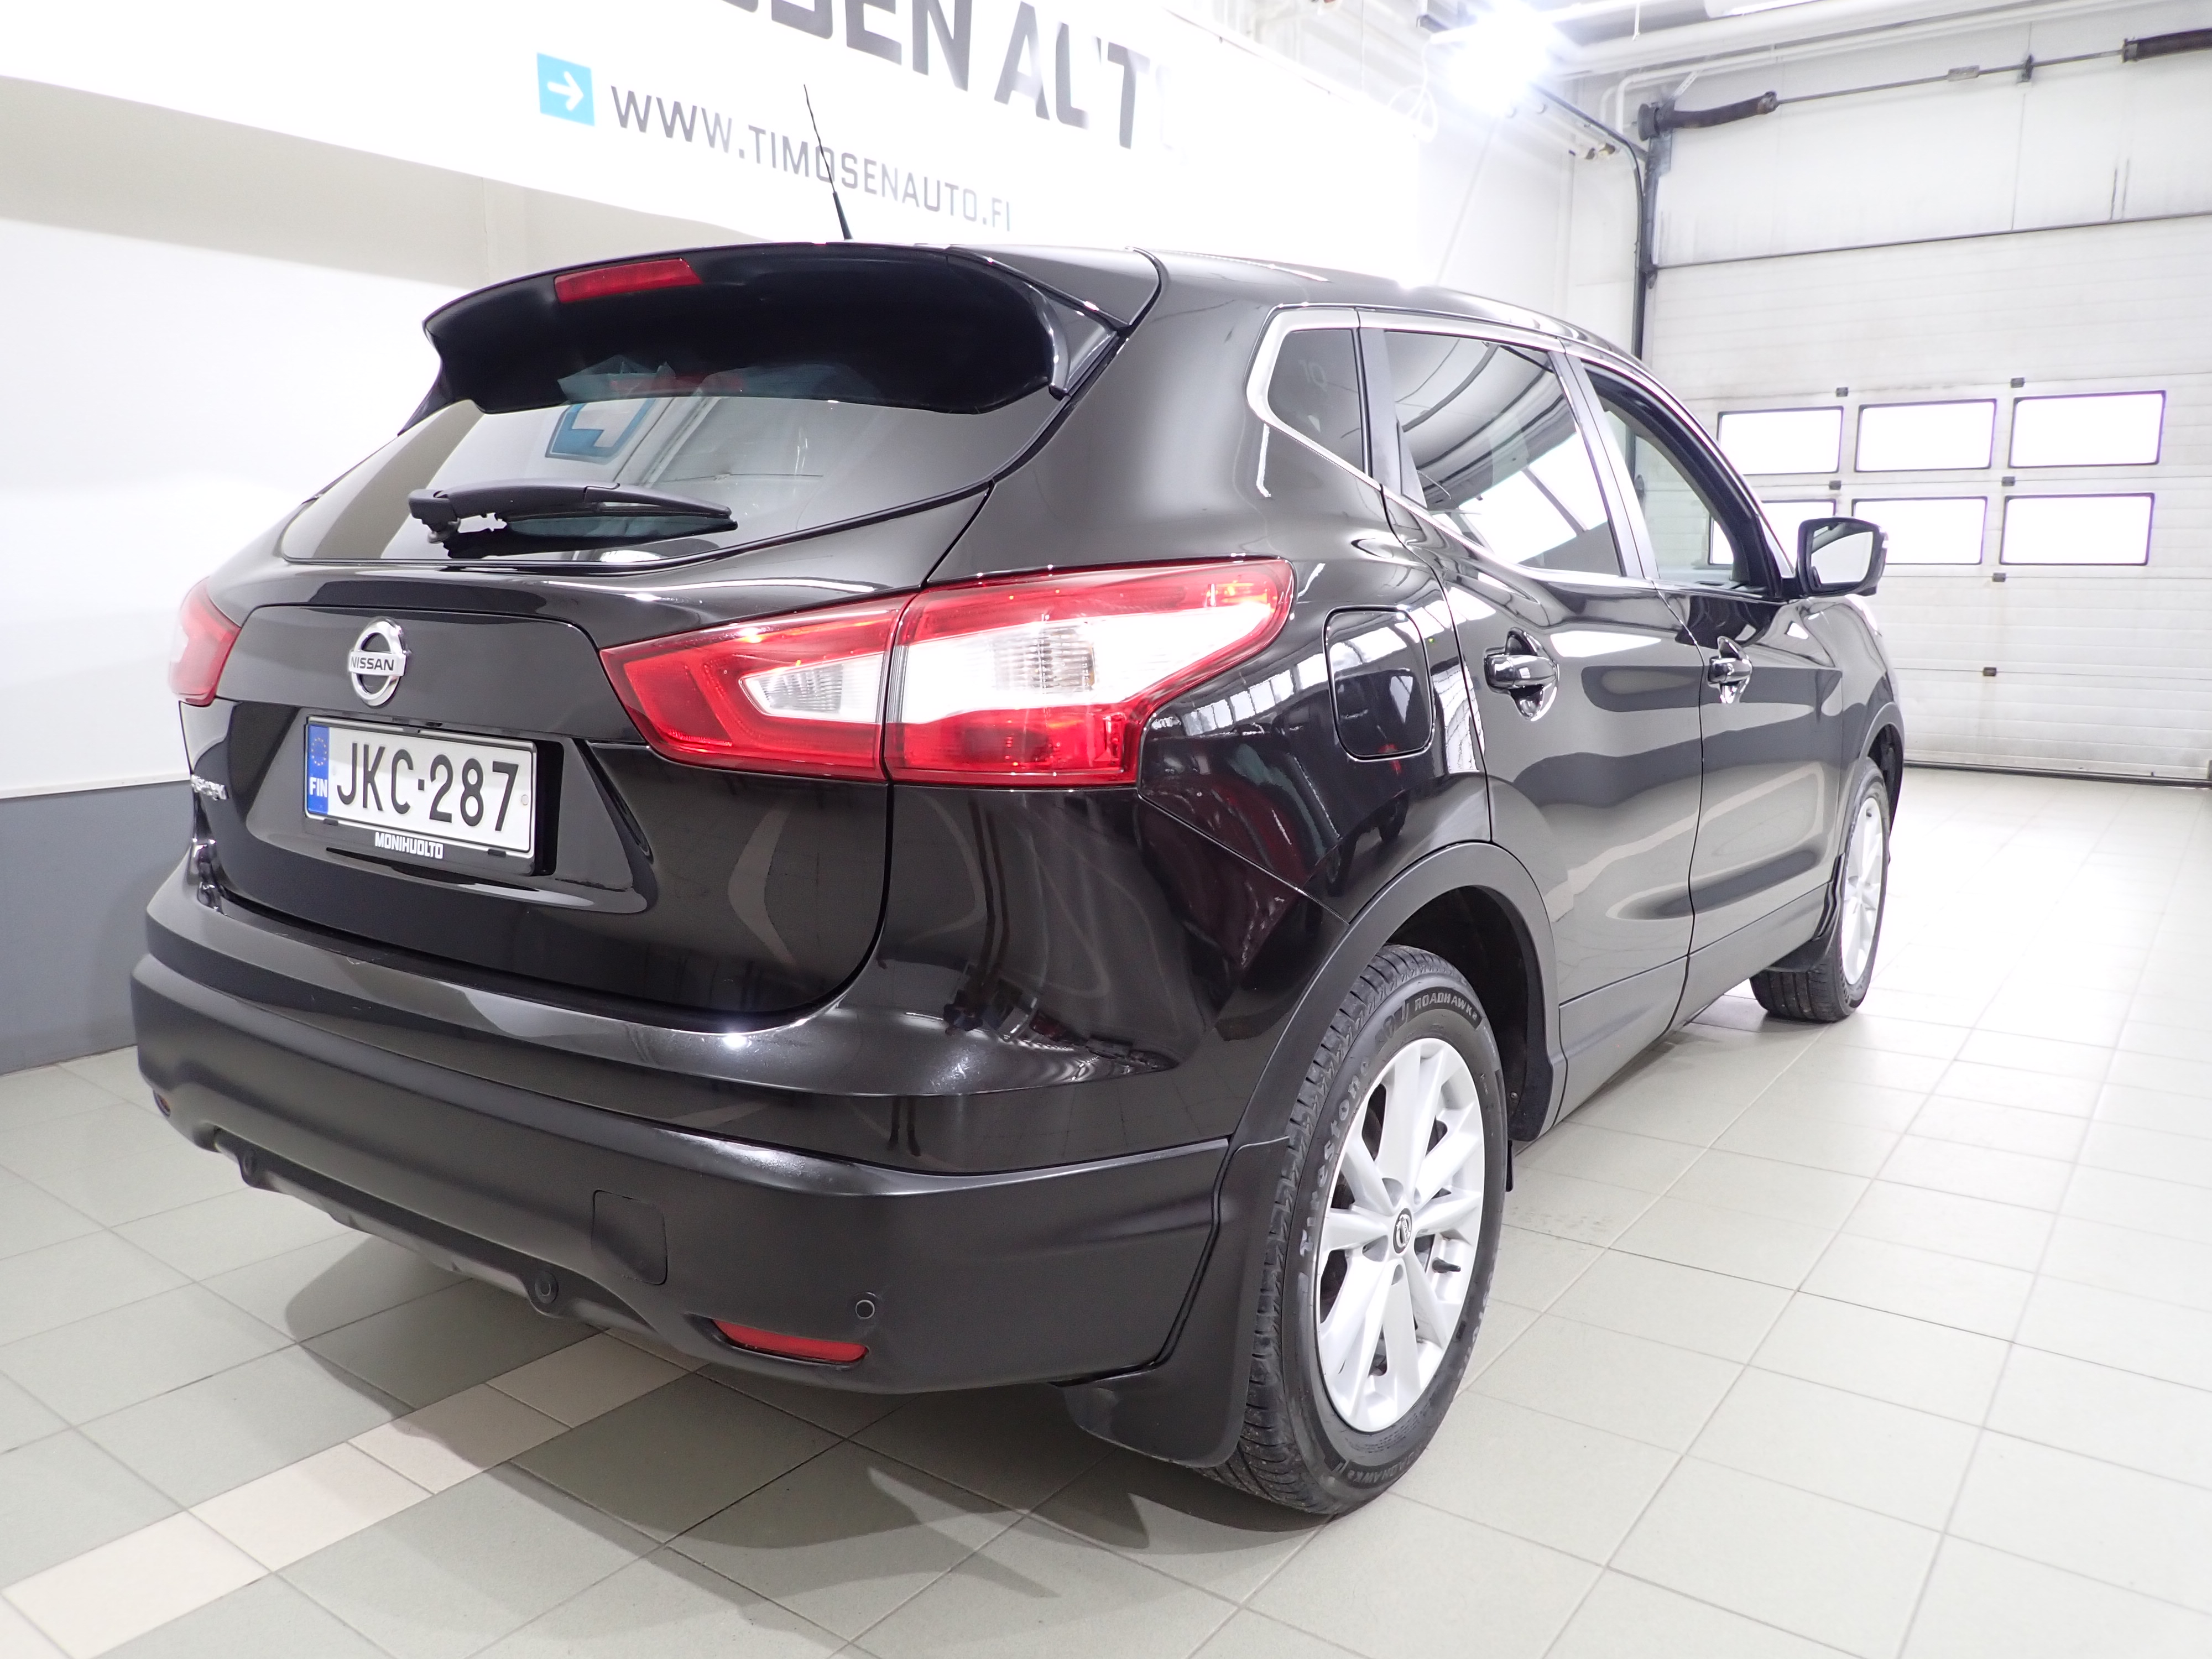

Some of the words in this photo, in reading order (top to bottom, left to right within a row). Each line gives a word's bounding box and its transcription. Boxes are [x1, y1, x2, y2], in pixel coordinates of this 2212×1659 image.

[611, 85, 1011, 232] WWW.TIMOSENAUTO.FI
[351, 656, 394, 671] NISSAN
[310, 776, 327, 797] FIN
[337, 742, 519, 831] JKC-287
[375, 832, 444, 859] MONIHUOLTO
